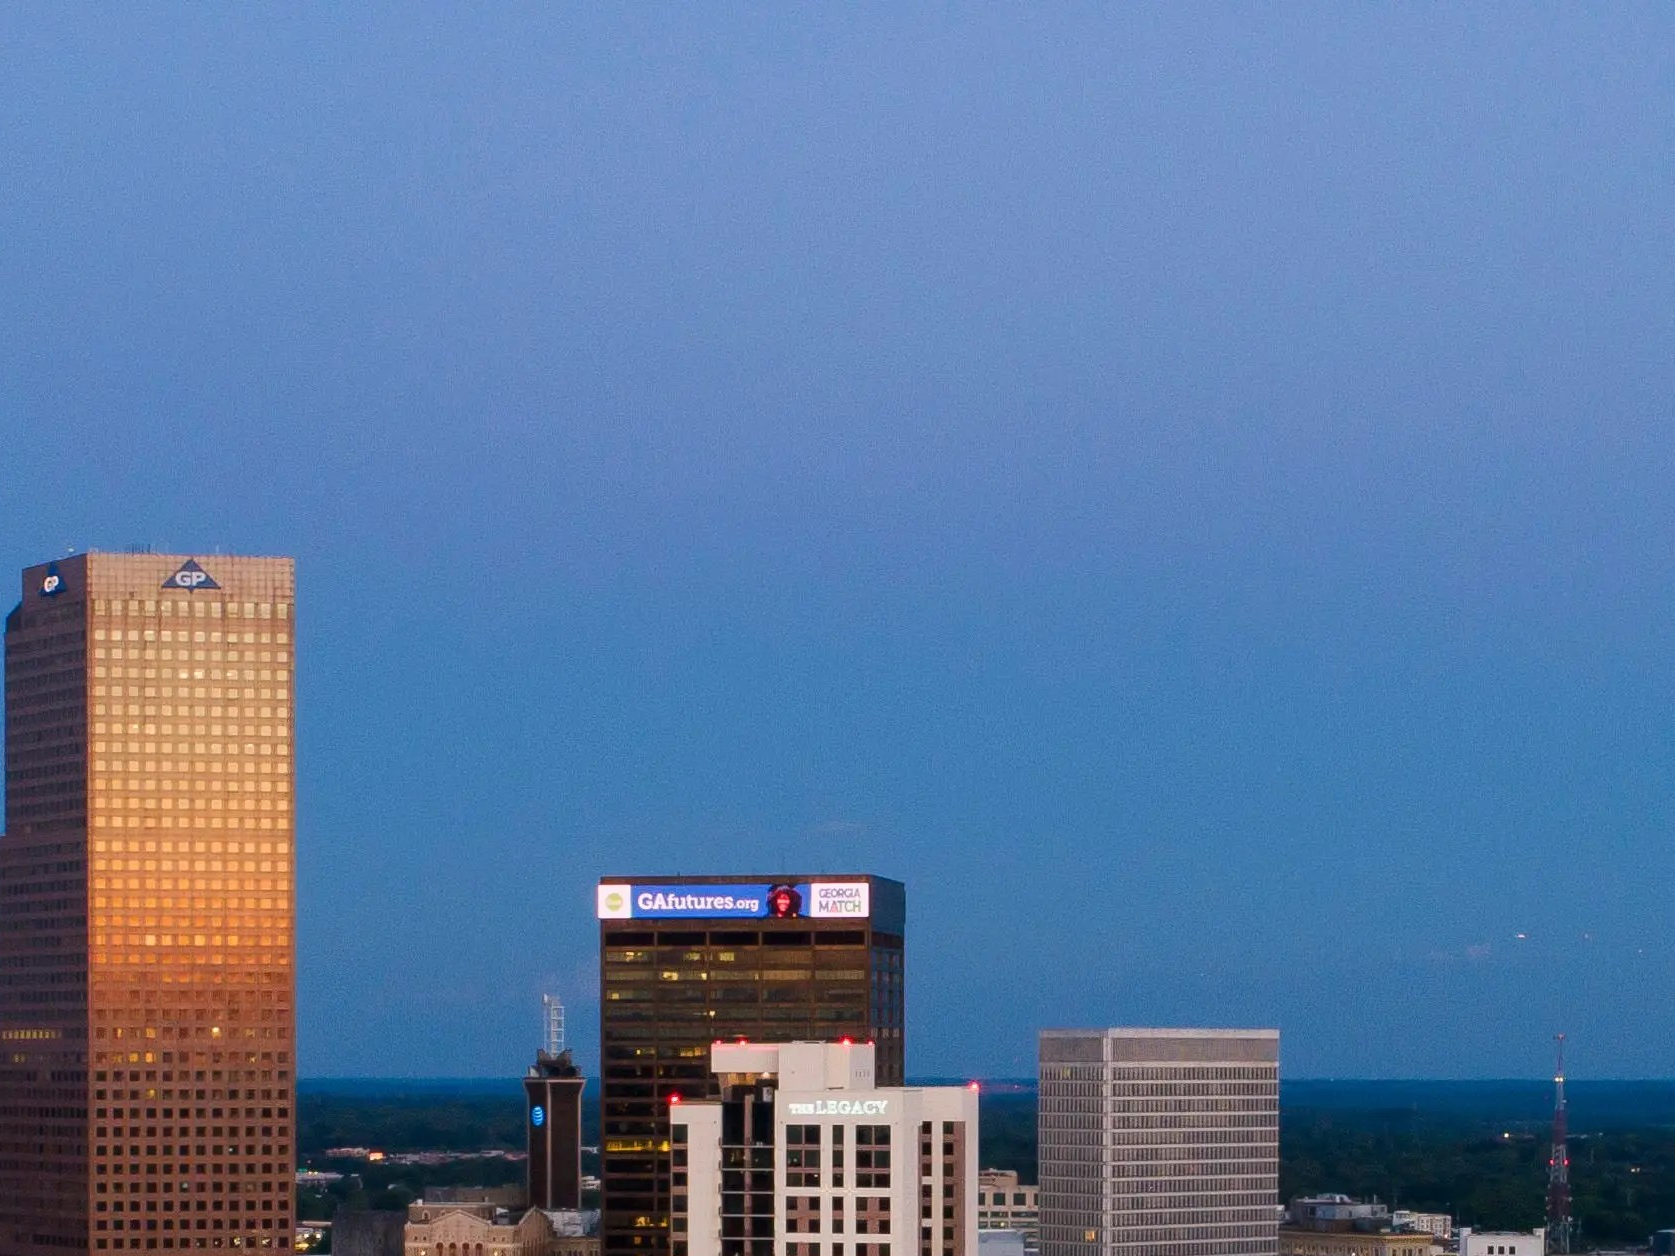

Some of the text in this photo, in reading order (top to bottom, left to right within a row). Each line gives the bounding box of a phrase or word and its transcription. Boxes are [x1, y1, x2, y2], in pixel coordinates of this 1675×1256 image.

[175, 572, 206, 587] GP
[819, 888, 861, 899] GEORGIA
[637, 893, 759, 912] GAfutures.org
[819, 901, 861, 913] MATCH
[815, 1100, 888, 1114] LEGACY
